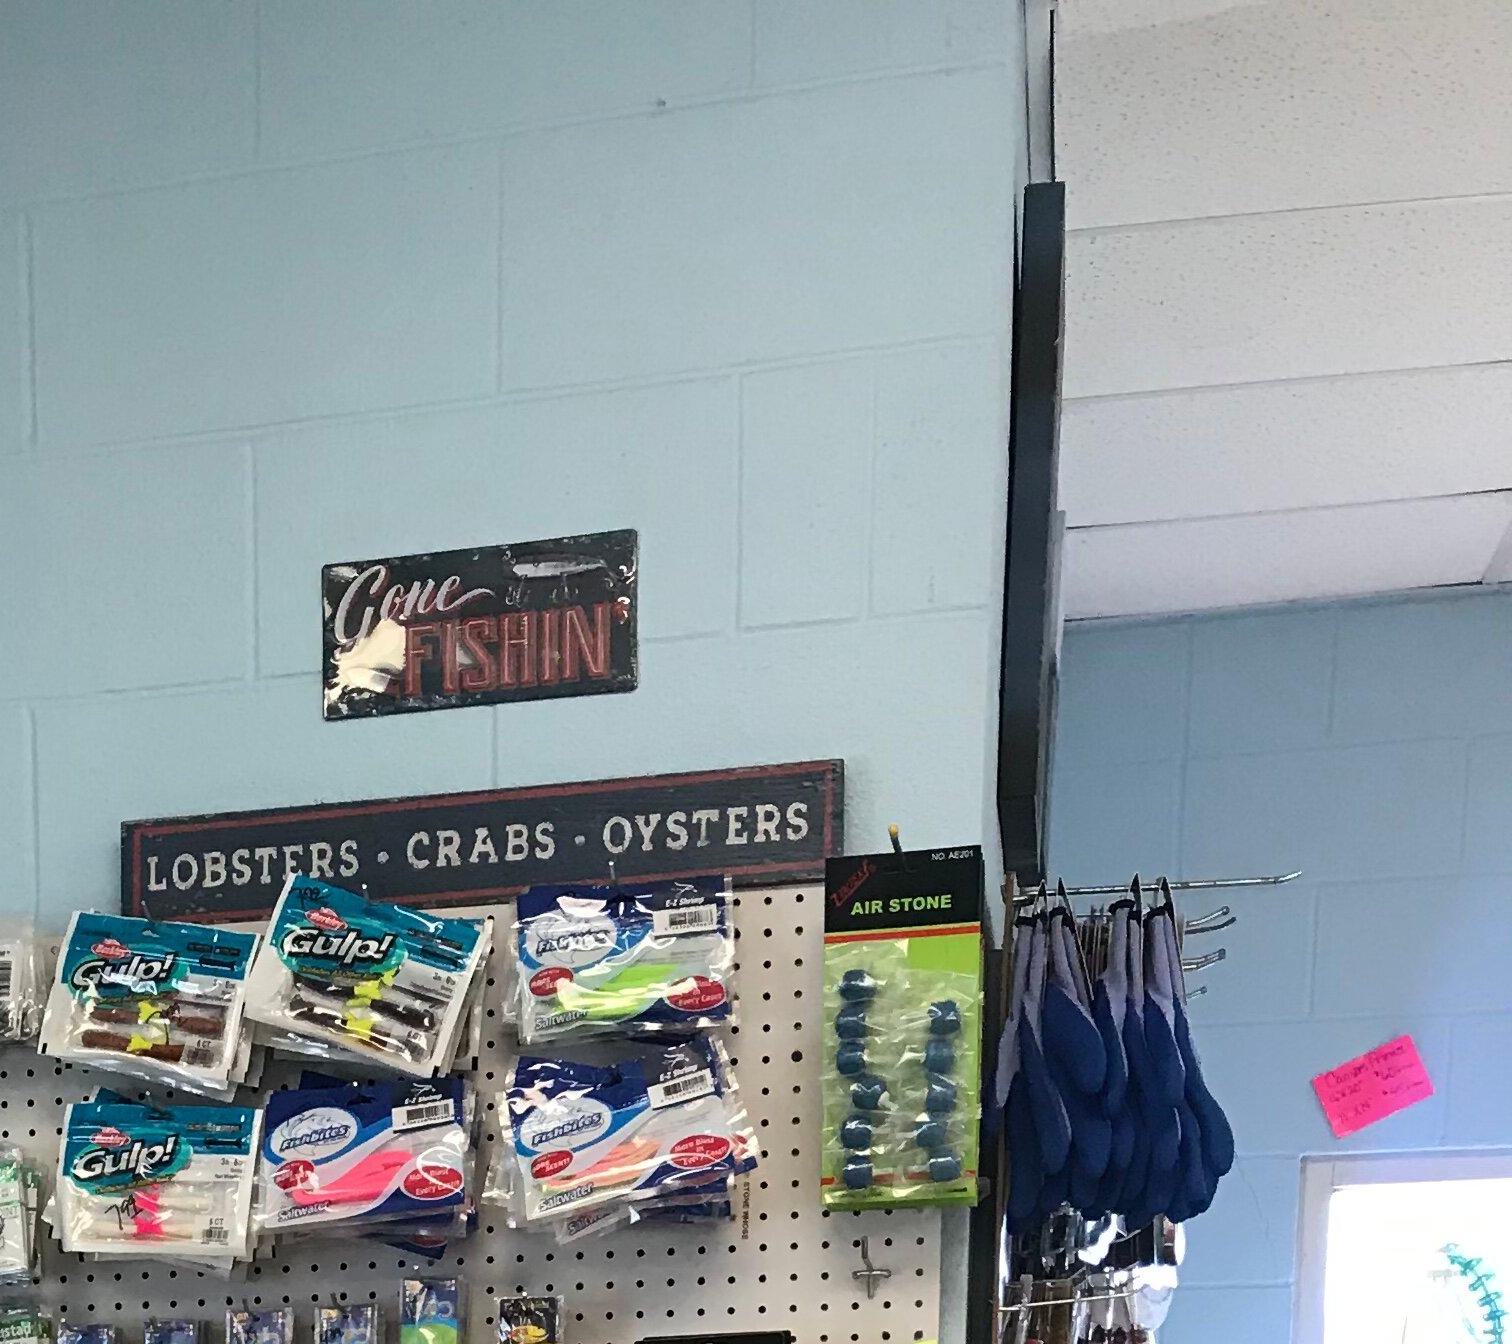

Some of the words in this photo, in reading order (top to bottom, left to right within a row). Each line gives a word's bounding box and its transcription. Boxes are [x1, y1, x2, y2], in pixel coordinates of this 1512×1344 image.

[334, 565, 496, 643] Gone
[147, 839, 360, 892] LOBSTERS
[406, 821, 556, 869] CRABS
[603, 802, 811, 854] OYSTERS
[850, 900, 883, 916] AIR
[888, 894, 952, 913] STONE
[283, 927, 394, 964] Gulp!
[72, 953, 175, 992] Gulp!
[279, 1124, 352, 1151] Fishbites
[531, 1111, 603, 1147] Fishbites
[72, 1136, 177, 1180] Gulp!
[538, 1181, 595, 1211] Saltwater
